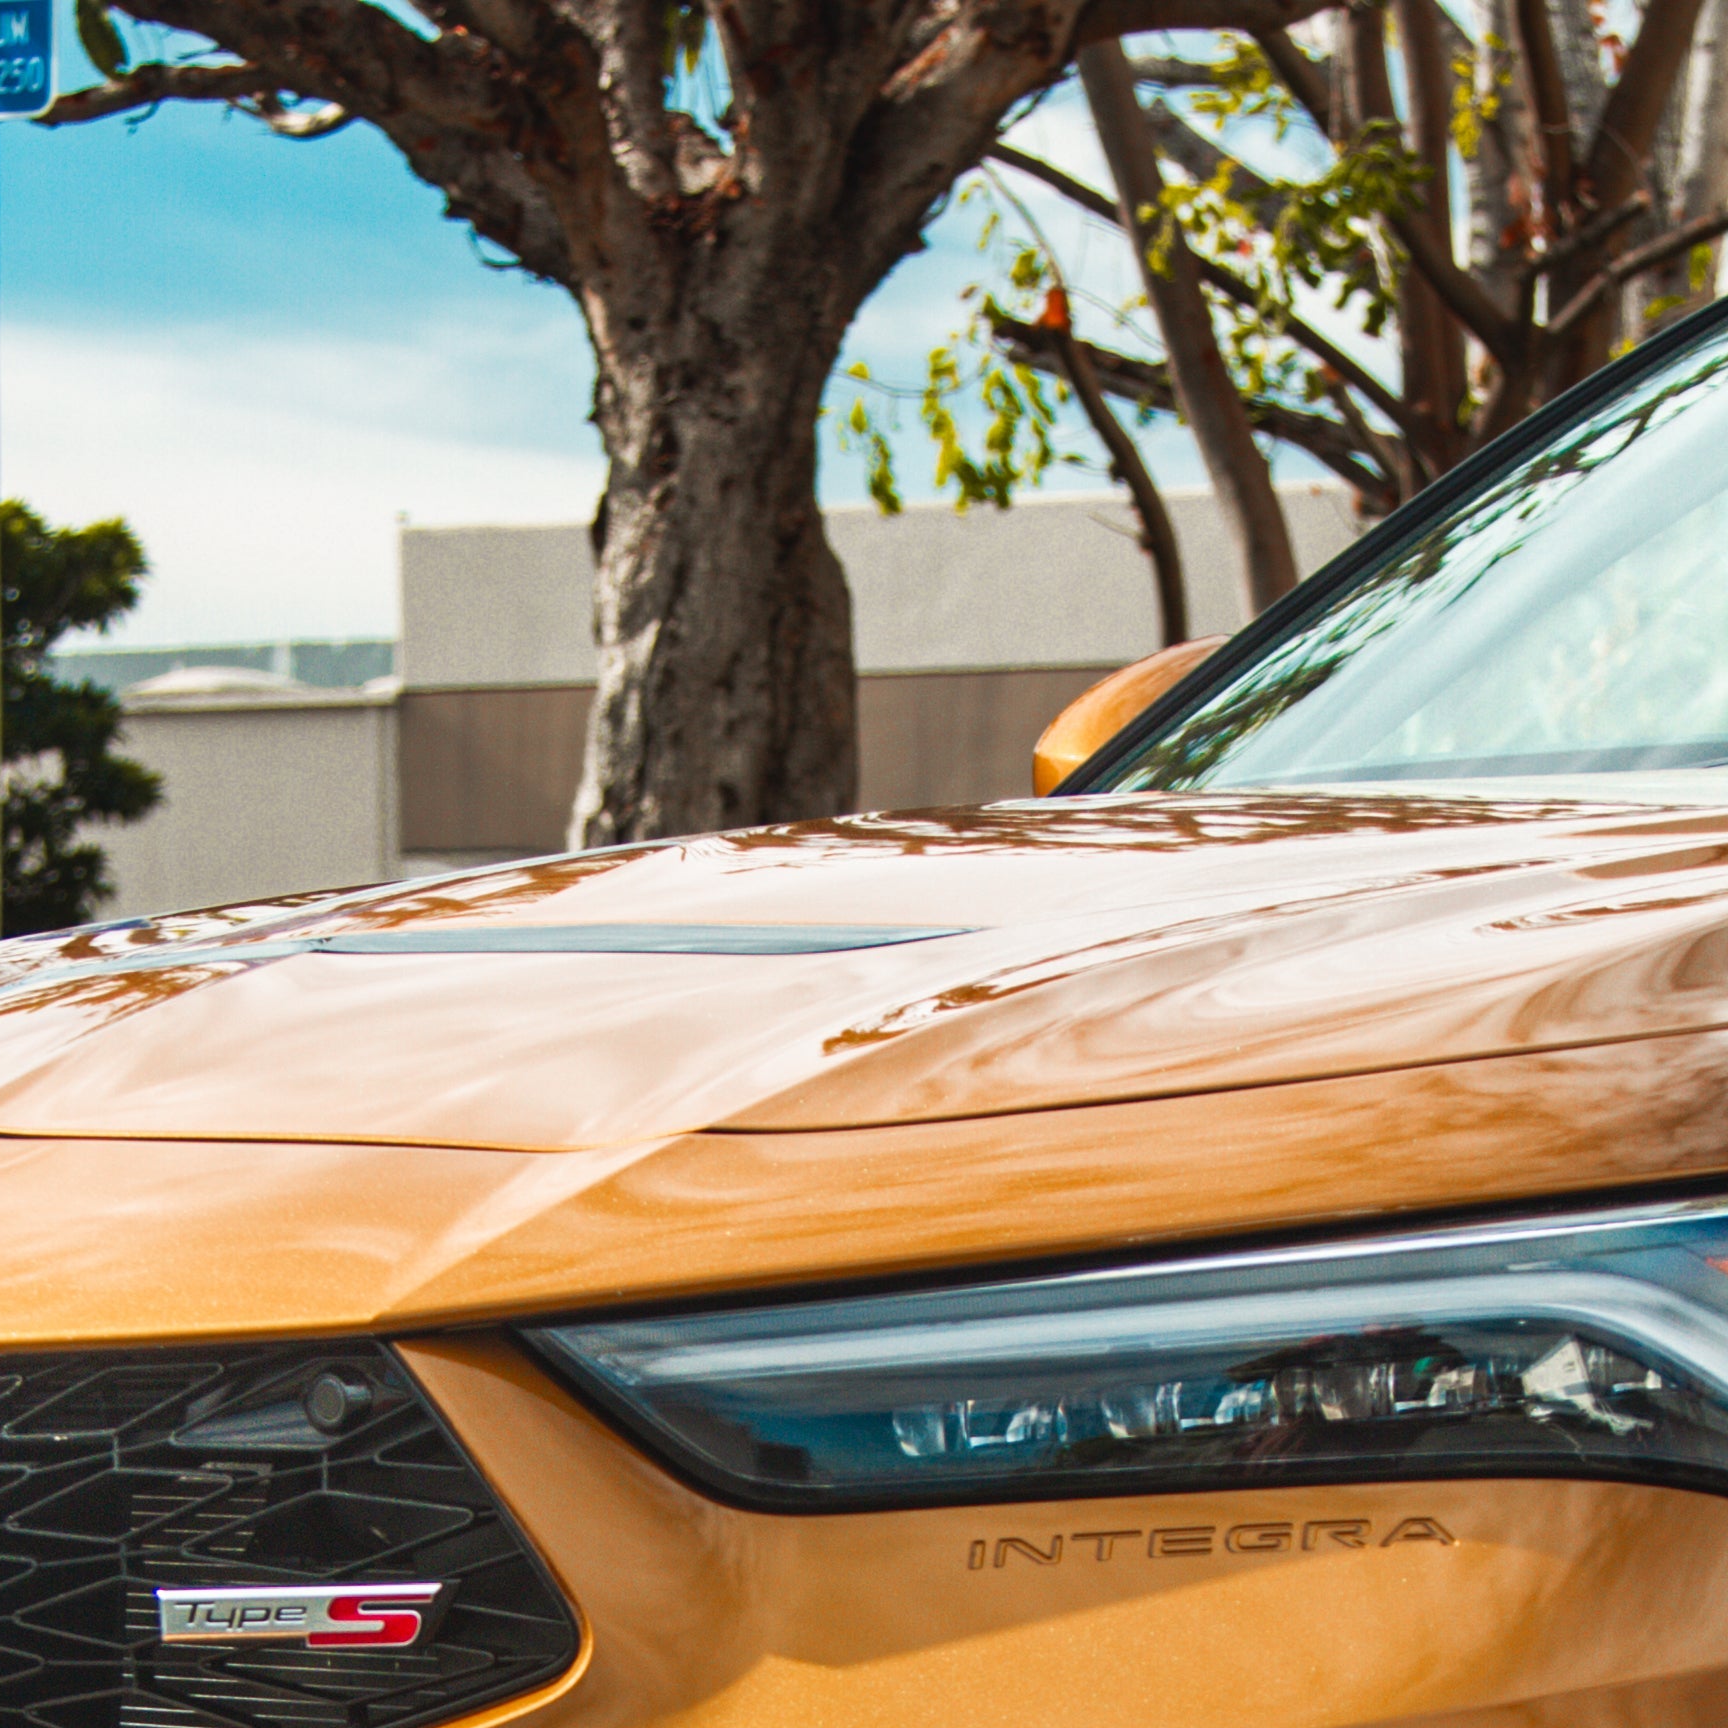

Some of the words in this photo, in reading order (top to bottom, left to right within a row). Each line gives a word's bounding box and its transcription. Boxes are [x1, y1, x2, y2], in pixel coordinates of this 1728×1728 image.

[968, 1516, 1459, 1569] INTEGRA
[173, 1600, 307, 1632] Type
[305, 1593, 436, 1649] S
